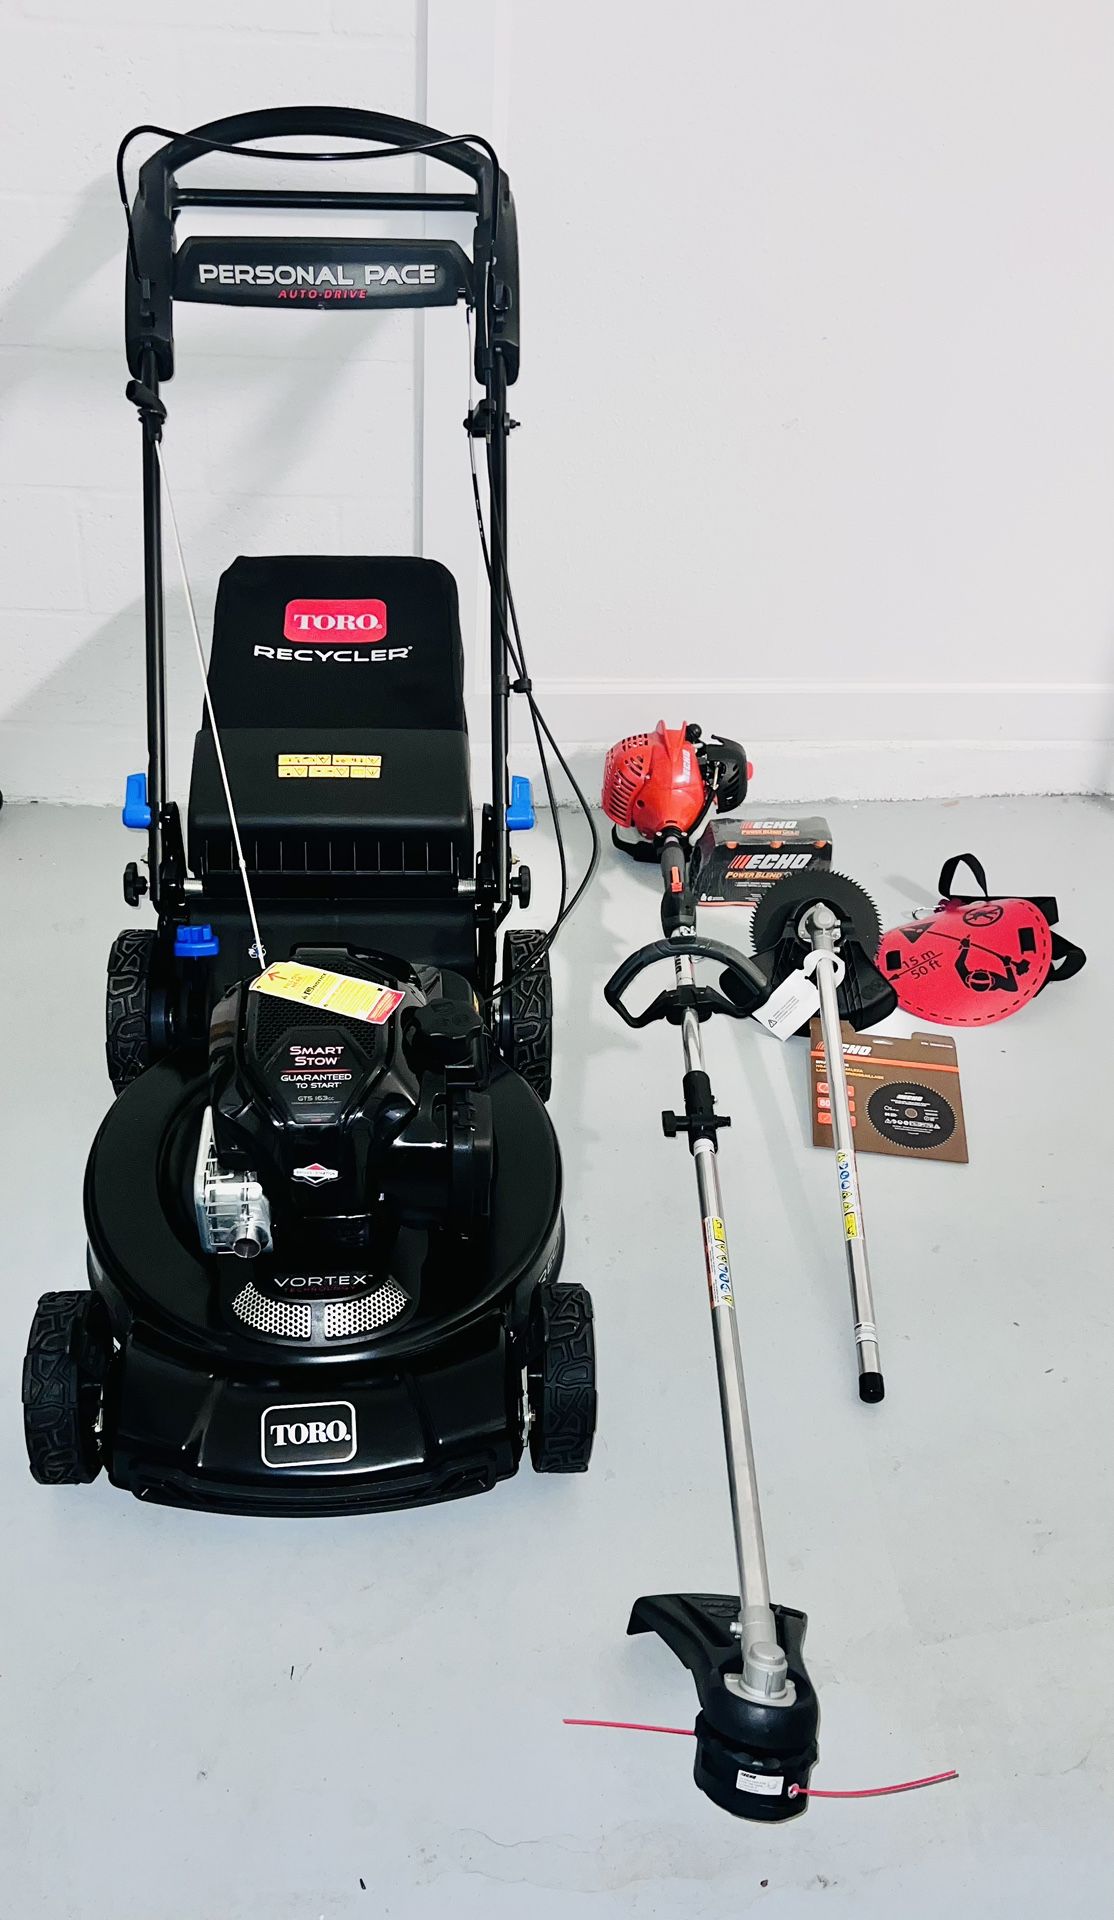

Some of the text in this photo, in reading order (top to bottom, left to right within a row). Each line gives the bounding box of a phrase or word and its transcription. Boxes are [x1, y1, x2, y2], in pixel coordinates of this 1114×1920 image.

[198, 264, 436, 286] PERSONAL PACE
[277, 289, 368, 299] AUTO-DRIVE
[253, 644, 409, 663] RECYCLER
[752, 820, 798, 829] ECHO
[745, 853, 812, 869] ECHO
[902, 950, 935, 969] 15 m
[910, 959, 942, 980] 50 ft
[289, 1045, 344, 1055] SMART
[294, 1056, 338, 1066] STOW
[280, 1073, 352, 1082] GUARANTEED
[273, 1275, 368, 1288] VORTEX
